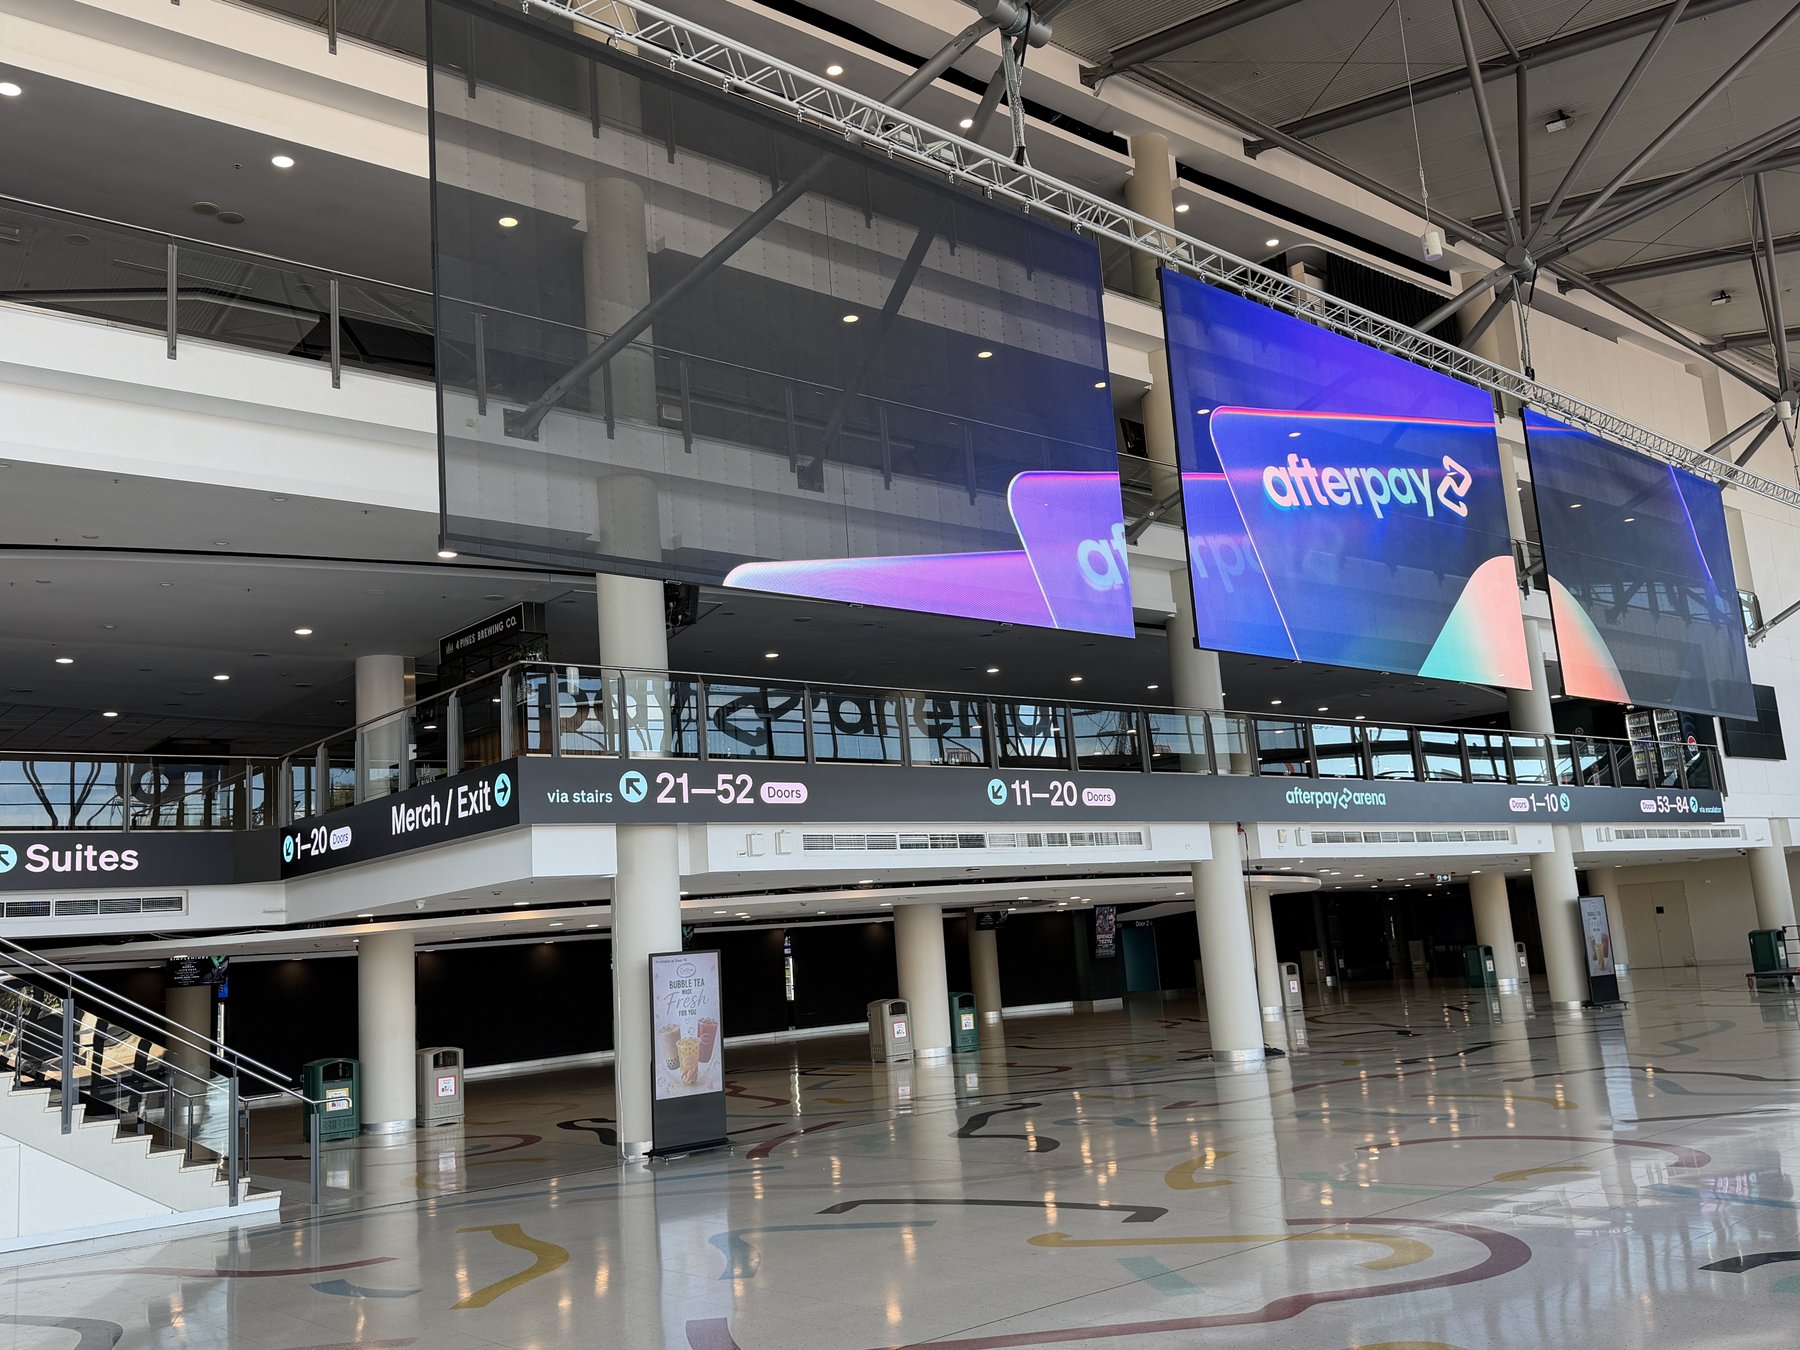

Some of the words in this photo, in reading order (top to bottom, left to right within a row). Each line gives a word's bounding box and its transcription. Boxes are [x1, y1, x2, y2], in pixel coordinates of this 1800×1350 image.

[1262, 453, 1435, 519] afterpay
[460, 633, 476, 648] PINES
[477, 621, 504, 641] BREWING
[547, 789, 570, 803] via
[572, 789, 613, 803] stairs
[767, 786, 802, 799] Doors
[1087, 791, 1112, 802] Doors
[1285, 786, 1339, 809] afterpay
[1352, 791, 1387, 806] arena
[391, 794, 441, 835] Merch
[457, 780, 492, 818] Exit
[1511, 799, 1528, 809] Doors
[332, 832, 349, 845] Doors
[24, 842, 139, 872] Suites
[669, 980, 693, 989] BUBBLE
[694, 978, 705, 988] TEA
[664, 989, 709, 1015] Fresh
